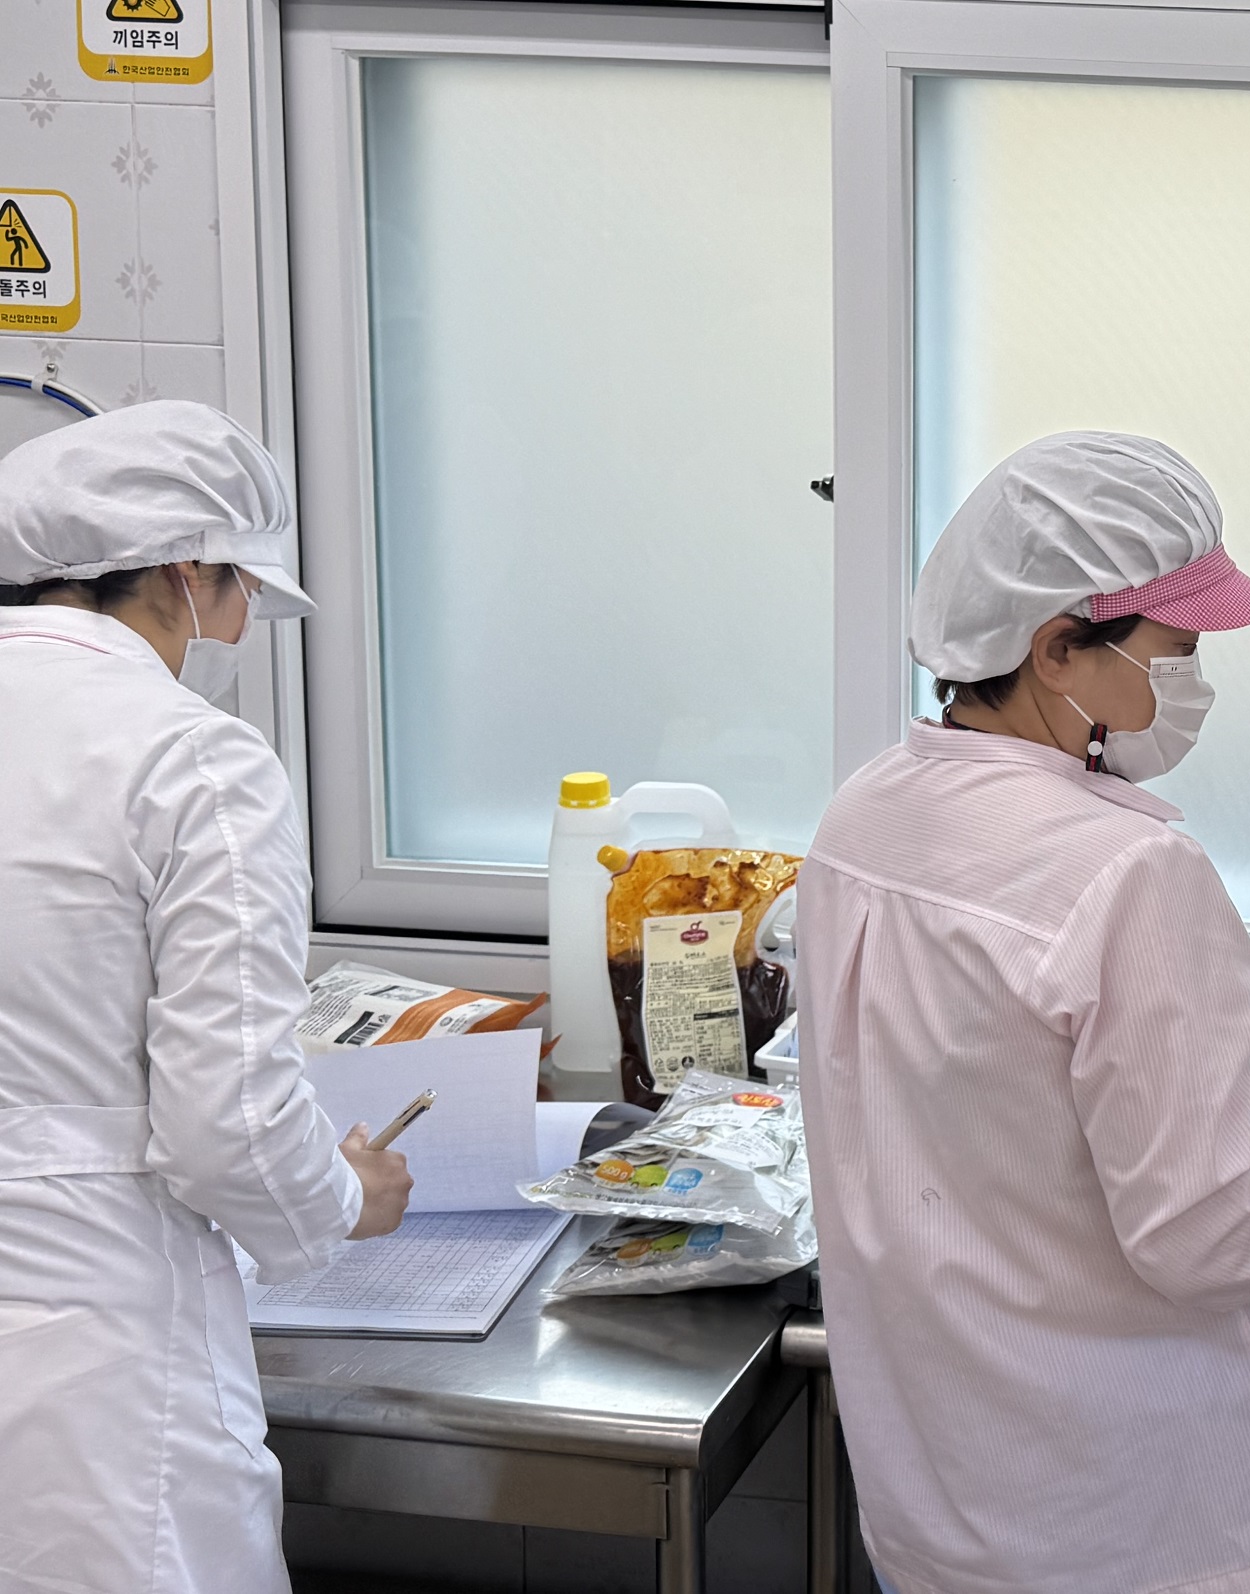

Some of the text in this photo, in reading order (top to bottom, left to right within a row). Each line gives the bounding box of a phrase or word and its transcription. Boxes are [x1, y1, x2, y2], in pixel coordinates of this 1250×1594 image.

[112, 28, 180, 50] 끼임주의
[122, 65, 190, 77] 한국산업안전협회
[0, 278, 47, 299] 돌주의
